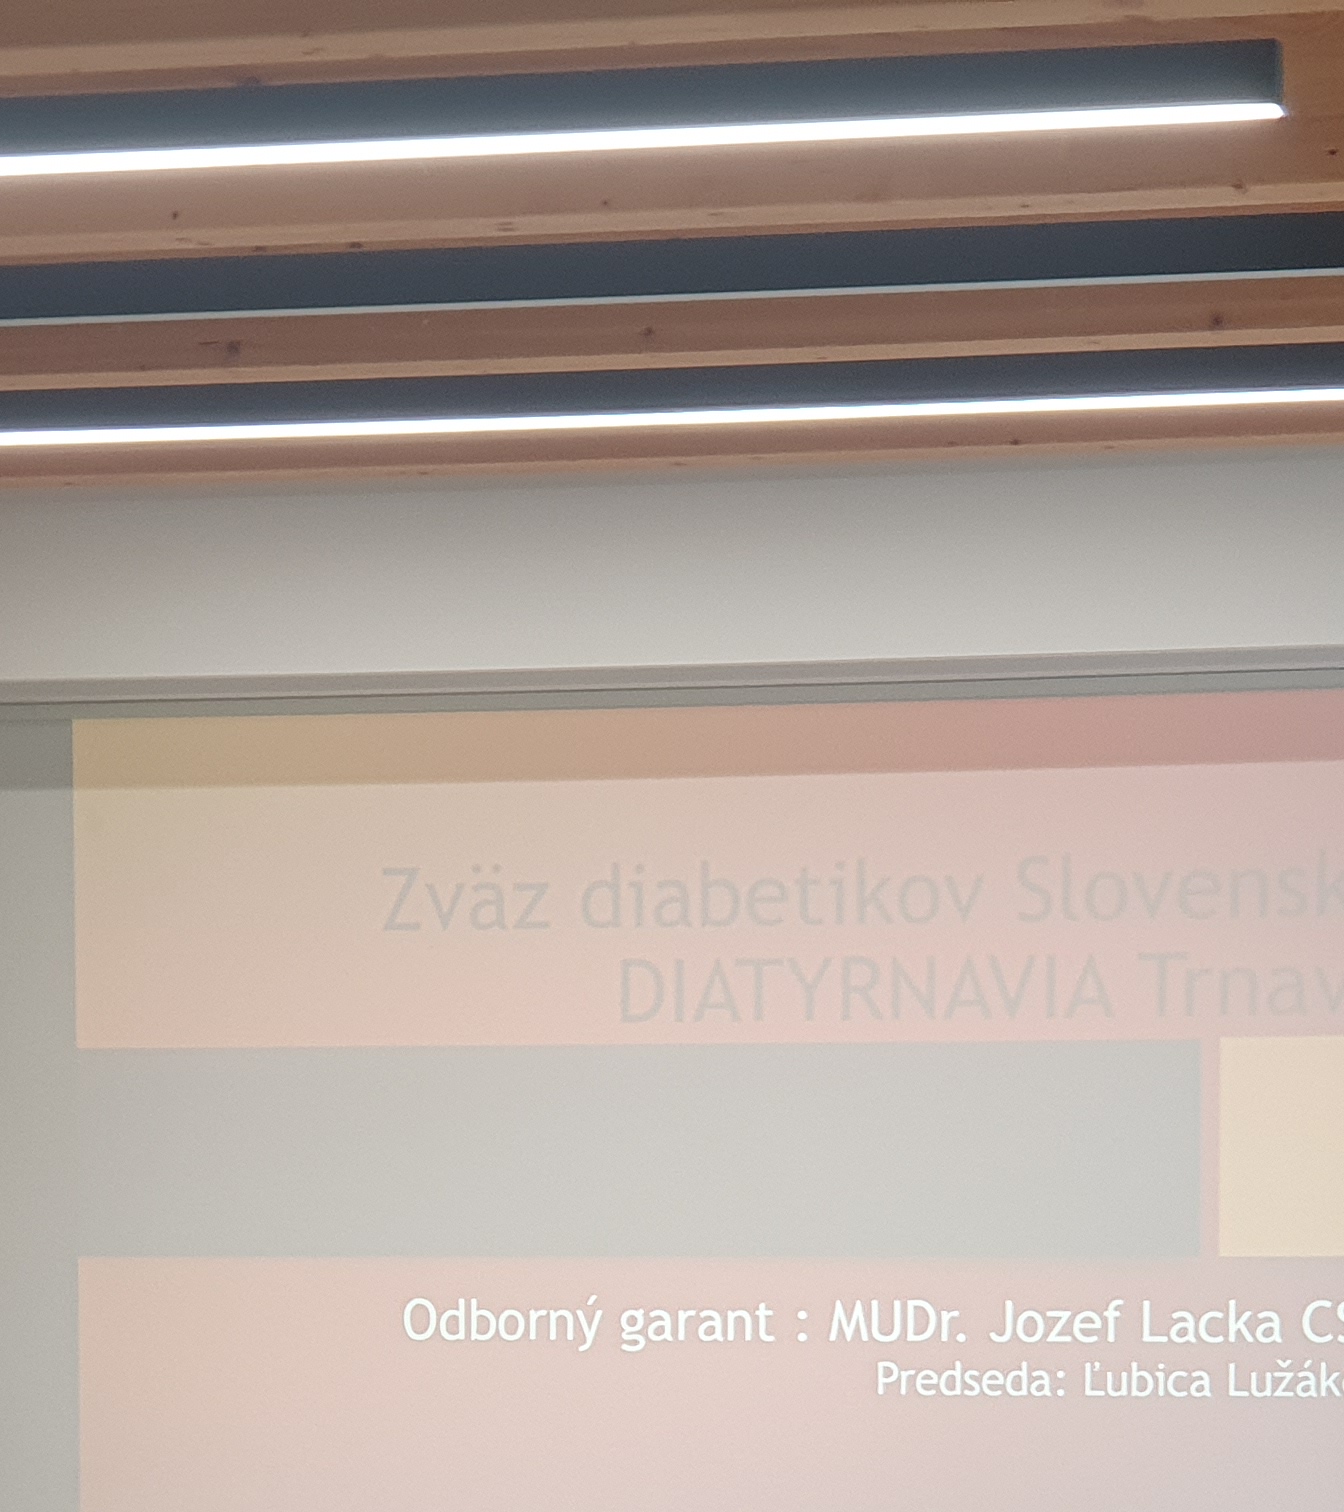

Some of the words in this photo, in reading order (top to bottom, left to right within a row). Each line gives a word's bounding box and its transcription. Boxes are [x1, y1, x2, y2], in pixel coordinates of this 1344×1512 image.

[380, 863, 551, 933] Zväz
[579, 856, 986, 930] diabetikov
[618, 954, 1116, 1025] DIATYRNAVIA
[403, 1294, 603, 1352] Odborný
[620, 1302, 775, 1352] garant
[829, 1299, 967, 1343] MUDr.
[989, 1299, 1124, 1343] Jozef
[1142, 1299, 1282, 1343] Lacka
[877, 1360, 1066, 1397] Predseda:
[1084, 1361, 1212, 1397] Ľubica
